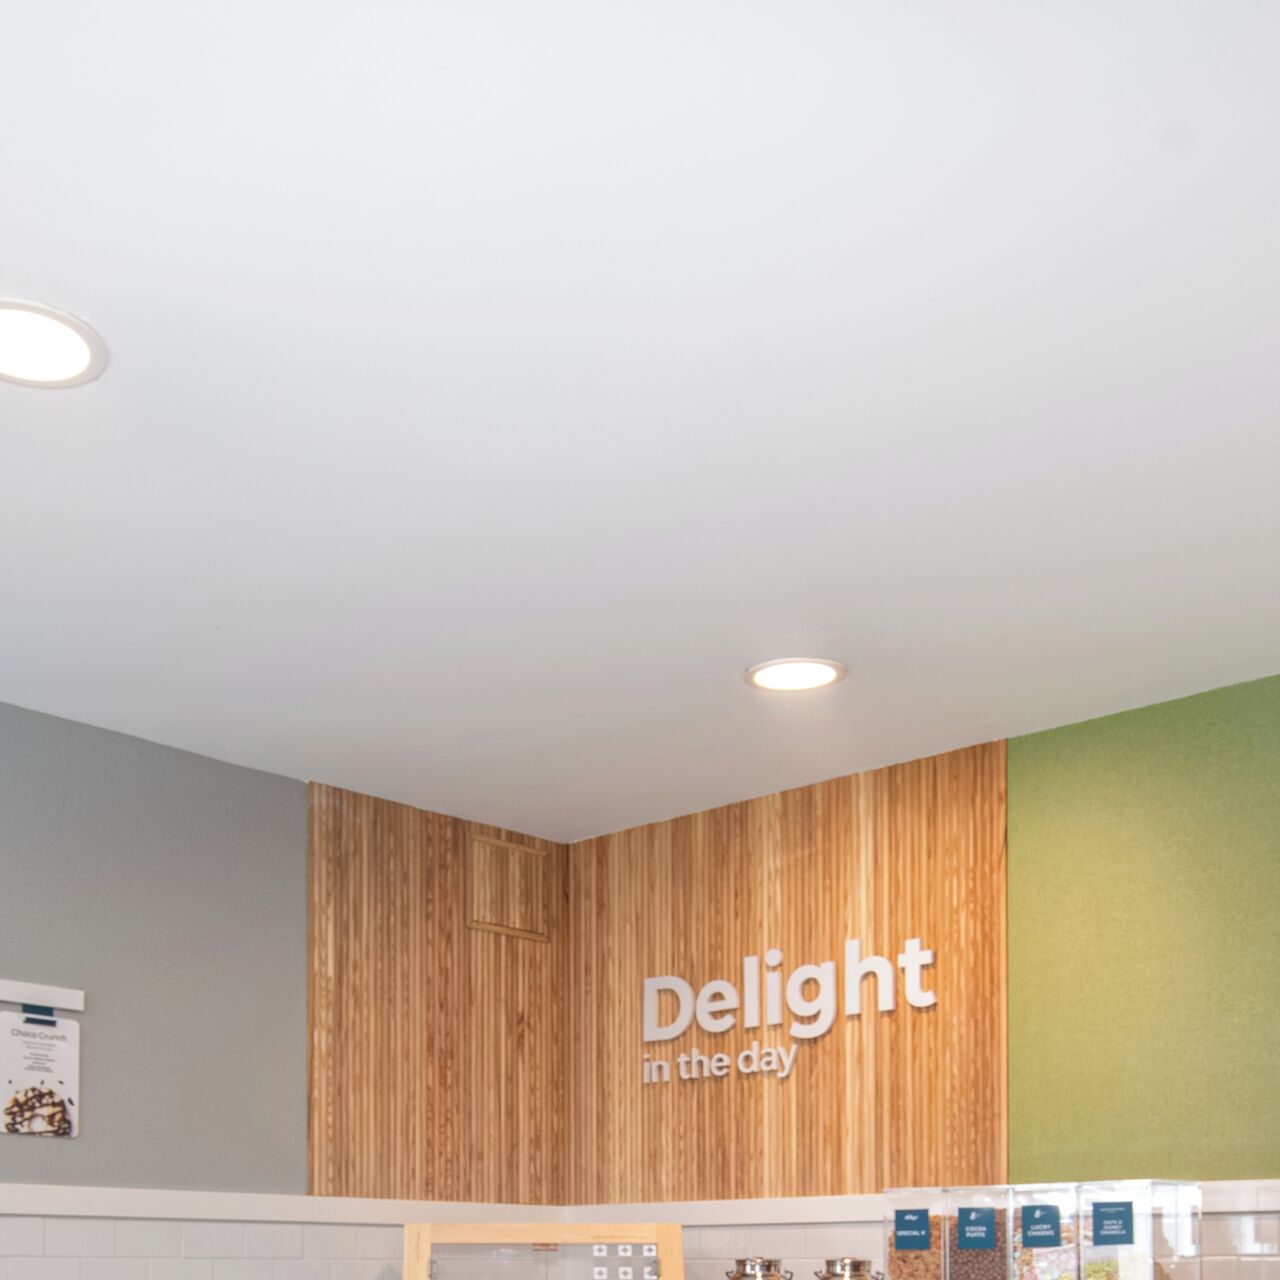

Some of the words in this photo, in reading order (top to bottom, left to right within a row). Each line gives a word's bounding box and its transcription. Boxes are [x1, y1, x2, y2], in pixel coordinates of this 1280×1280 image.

[643, 937, 937, 1042] Delight
[643, 1054, 670, 1084] in
[678, 1048, 730, 1080] the
[737, 1041, 797, 1079] day
